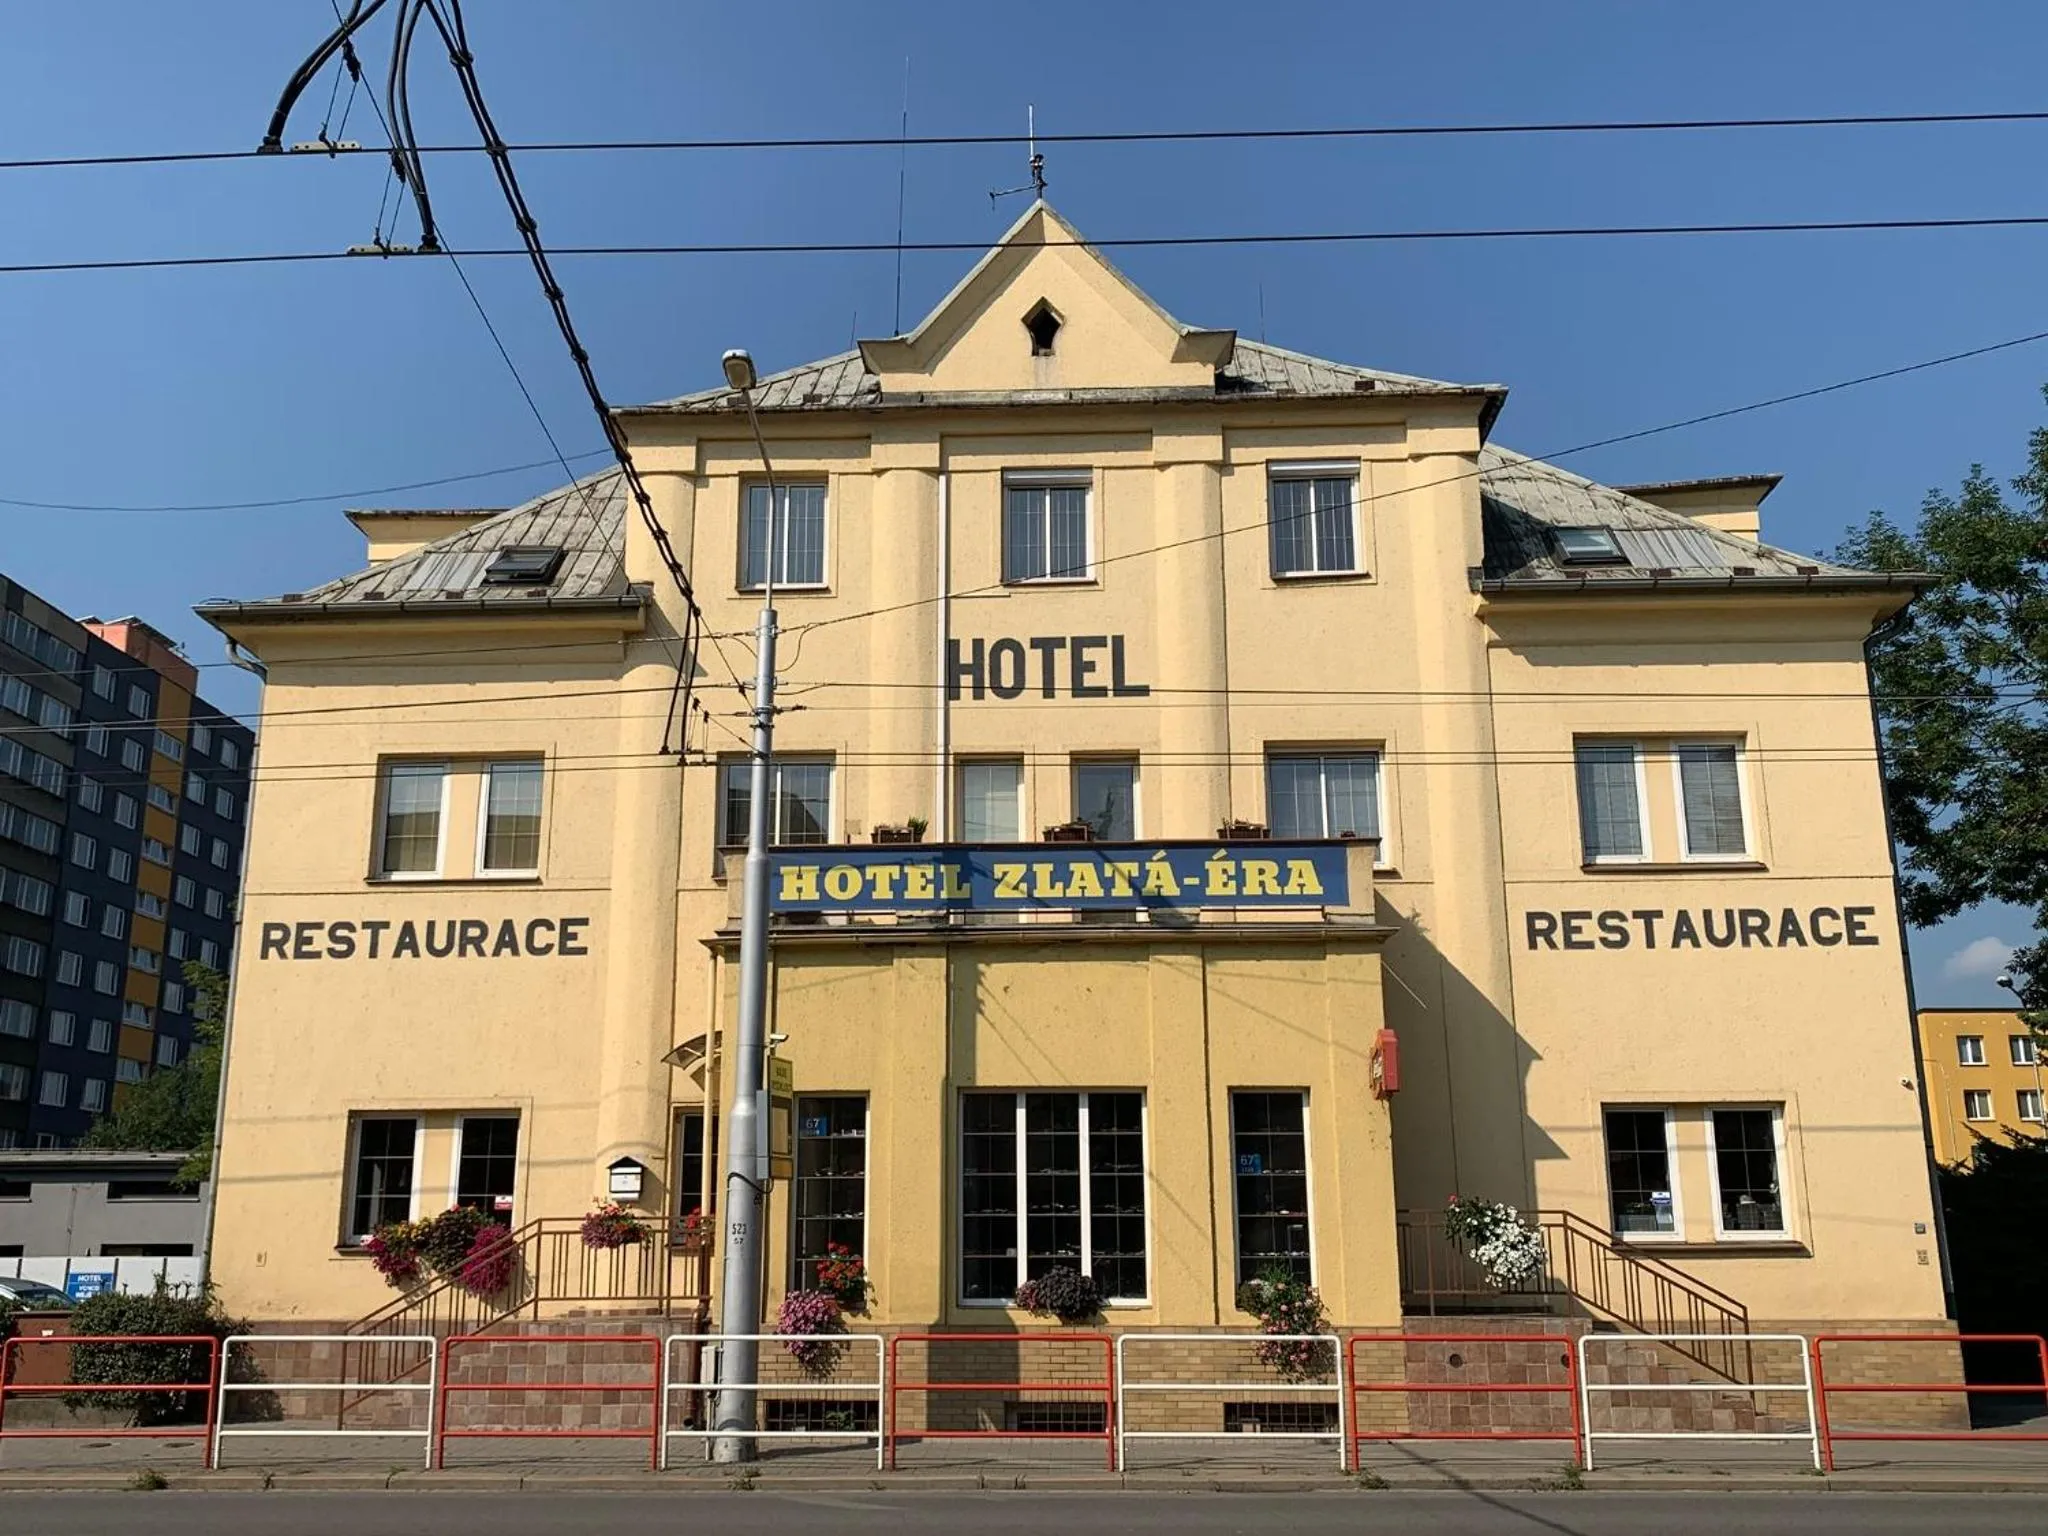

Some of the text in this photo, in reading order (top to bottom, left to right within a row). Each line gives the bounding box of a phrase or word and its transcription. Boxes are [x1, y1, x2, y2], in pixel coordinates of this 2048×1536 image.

[949, 634, 1150, 701] HOTEL
[780, 849, 1323, 901] HOTEL ZLATÁ-ÉRA
[260, 917, 590, 961] RESTAURACE
[1525, 906, 1880, 951] RESTAURACE
[805, 1117, 820, 1129] 67
[1240, 1154, 1254, 1166] 67
